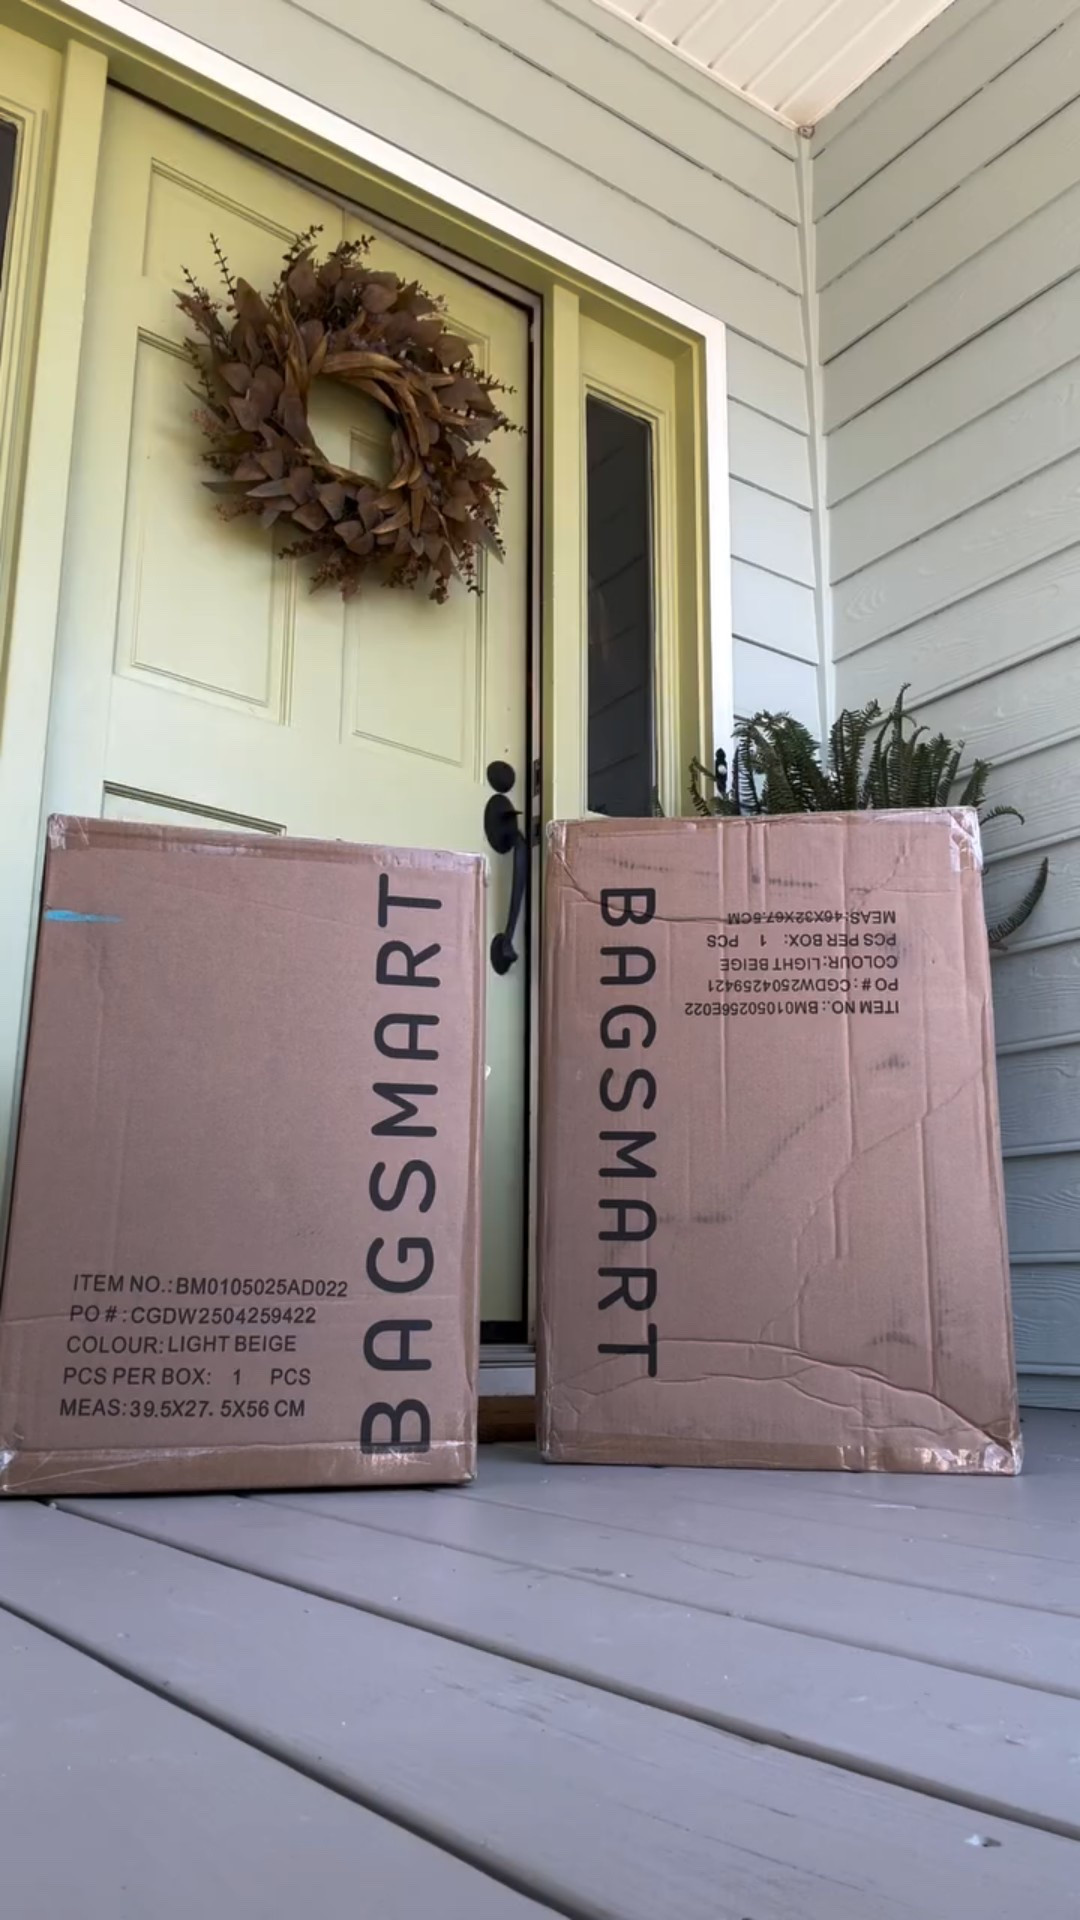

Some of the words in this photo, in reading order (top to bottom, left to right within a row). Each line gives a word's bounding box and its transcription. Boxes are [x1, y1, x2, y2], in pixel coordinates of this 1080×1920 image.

[706, 934, 739, 948] PCS
[759, 933, 767, 947] 1
[783, 933, 823, 947] BOX:
[826, 933, 860, 947] PER
[863, 933, 897, 948] PCS
[720, 957, 769, 972] BEIGE
[874, 977, 899, 992] PO
[859, 999, 900, 1015] ITEM
[597, 887, 663, 1378] BAGSMART
[360, 873, 442, 1455] BAGSMART
[73, 1274, 124, 1293] ITEM
[69, 1304, 100, 1323] PO
[234, 1335, 297, 1353] BEIGE
[63, 1366, 107, 1386] PCS
[112, 1367, 156, 1386] PER
[161, 1367, 211, 1386] BOX:
[233, 1368, 241, 1386] 1
[270, 1367, 311, 1386] PCS
